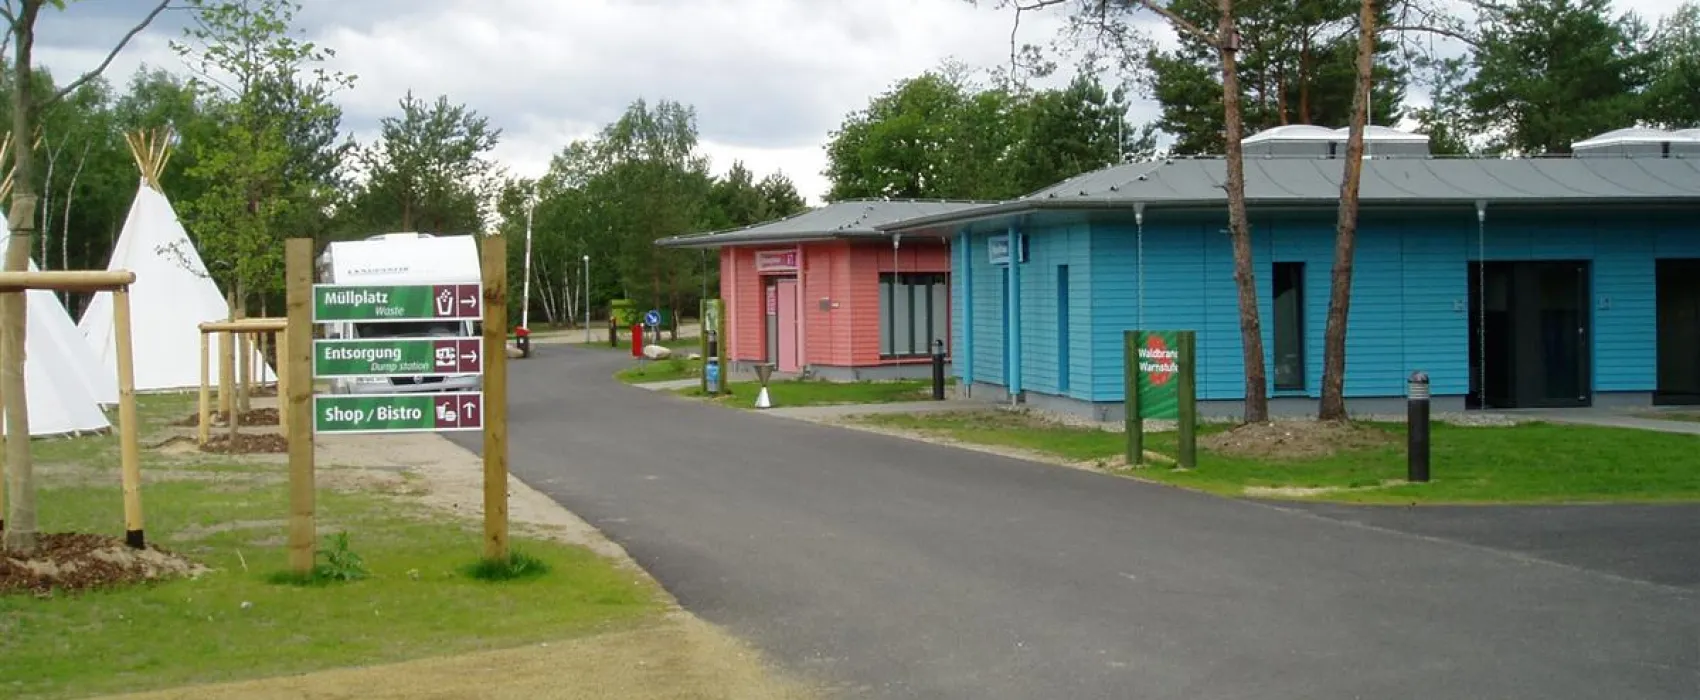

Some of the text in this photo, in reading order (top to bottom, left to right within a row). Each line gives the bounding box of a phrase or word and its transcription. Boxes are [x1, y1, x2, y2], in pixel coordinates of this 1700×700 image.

[324, 289, 388, 307] Müllplatz
[375, 305, 405, 317] Waste
[324, 346, 402, 361] Entsorgung
[370, 361, 430, 372] Dump station
[324, 405, 422, 424] Shop / Bistro
